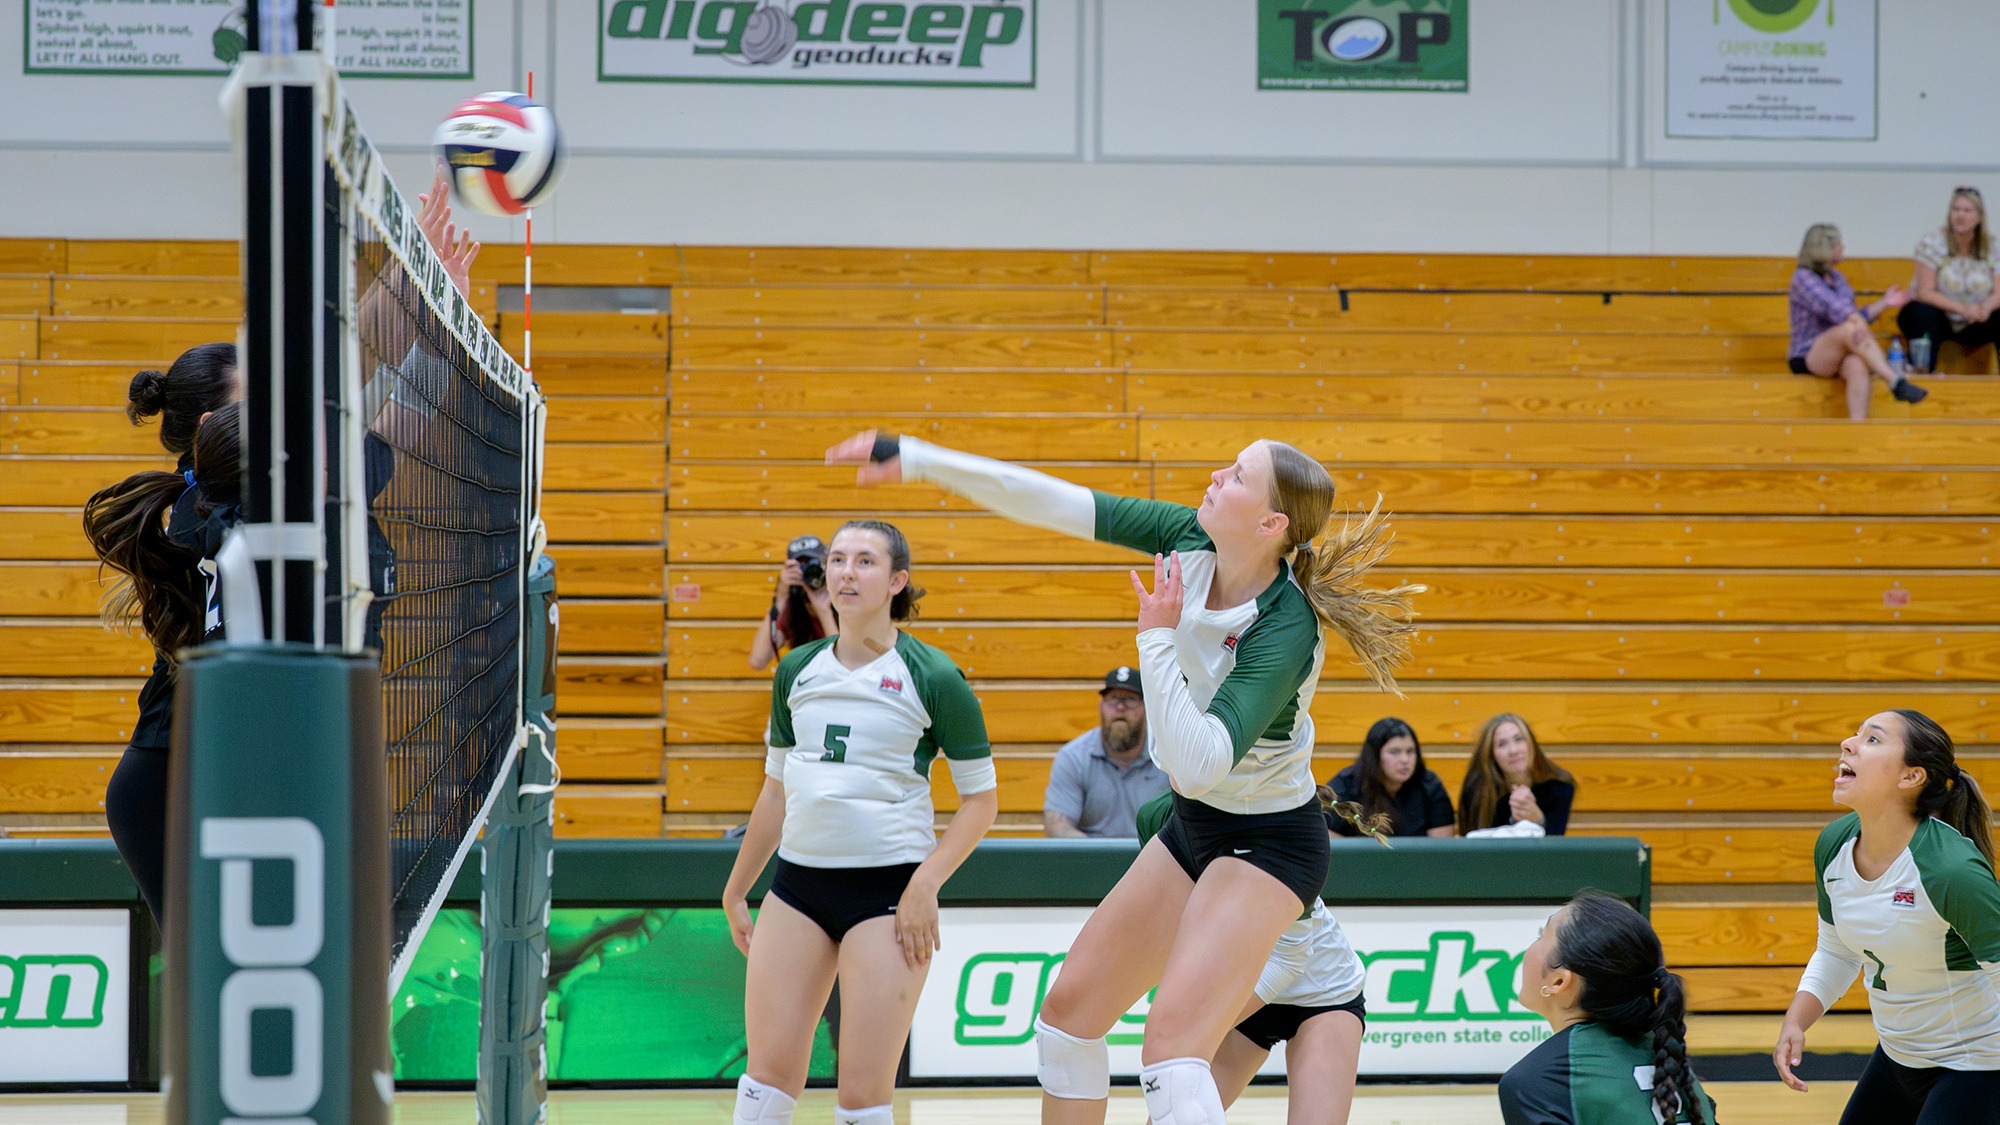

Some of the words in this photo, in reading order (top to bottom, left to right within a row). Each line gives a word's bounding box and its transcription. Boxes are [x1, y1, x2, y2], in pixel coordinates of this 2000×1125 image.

[117, 24, 153, 36] squirt
[796, 0, 1023, 67] deep
[1278, 10, 1450, 62] TOP
[80, 38, 94, 48] all
[36, 53, 59, 64] LET
[64, 53, 75, 64] IT
[79, 53, 103, 64] ALL
[107, 54, 148, 65] HANG
[359, 56, 381, 66] ALL
[385, 57, 426, 67] HANG
[793, 47, 963, 68] geoducks
[820, 724, 851, 763] 5
[200, 817, 325, 1125] po
[0, 954, 109, 1028] n
[1361, 1031, 1447, 1048] vergreen
[1453, 1029, 1503, 1043] state
[1509, 1025, 1553, 1043] colle
